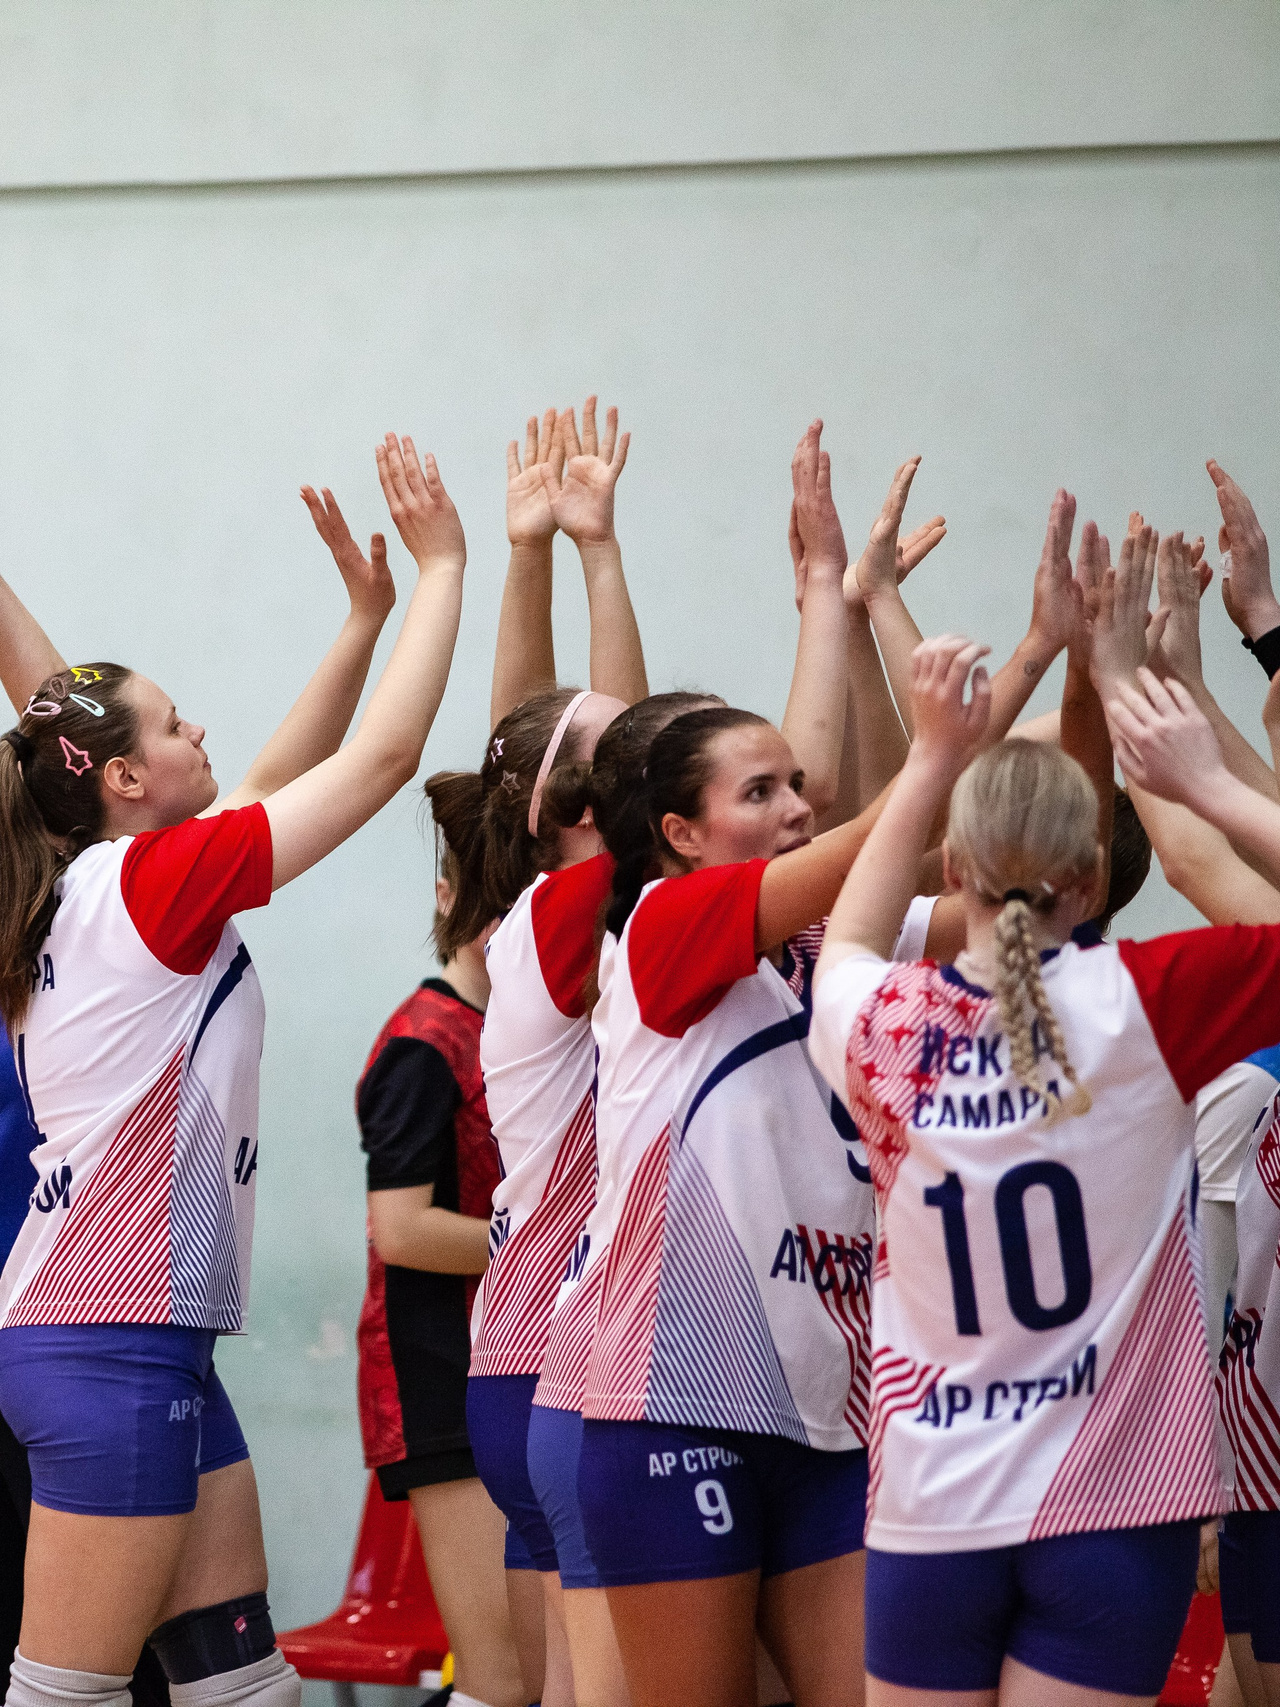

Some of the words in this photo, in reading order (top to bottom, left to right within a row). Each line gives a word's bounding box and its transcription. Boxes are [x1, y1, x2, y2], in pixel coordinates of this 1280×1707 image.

[924, 1160, 1093, 1337] 10
[649, 1452, 678, 1478] АР
[694, 1479, 734, 1535] 9
